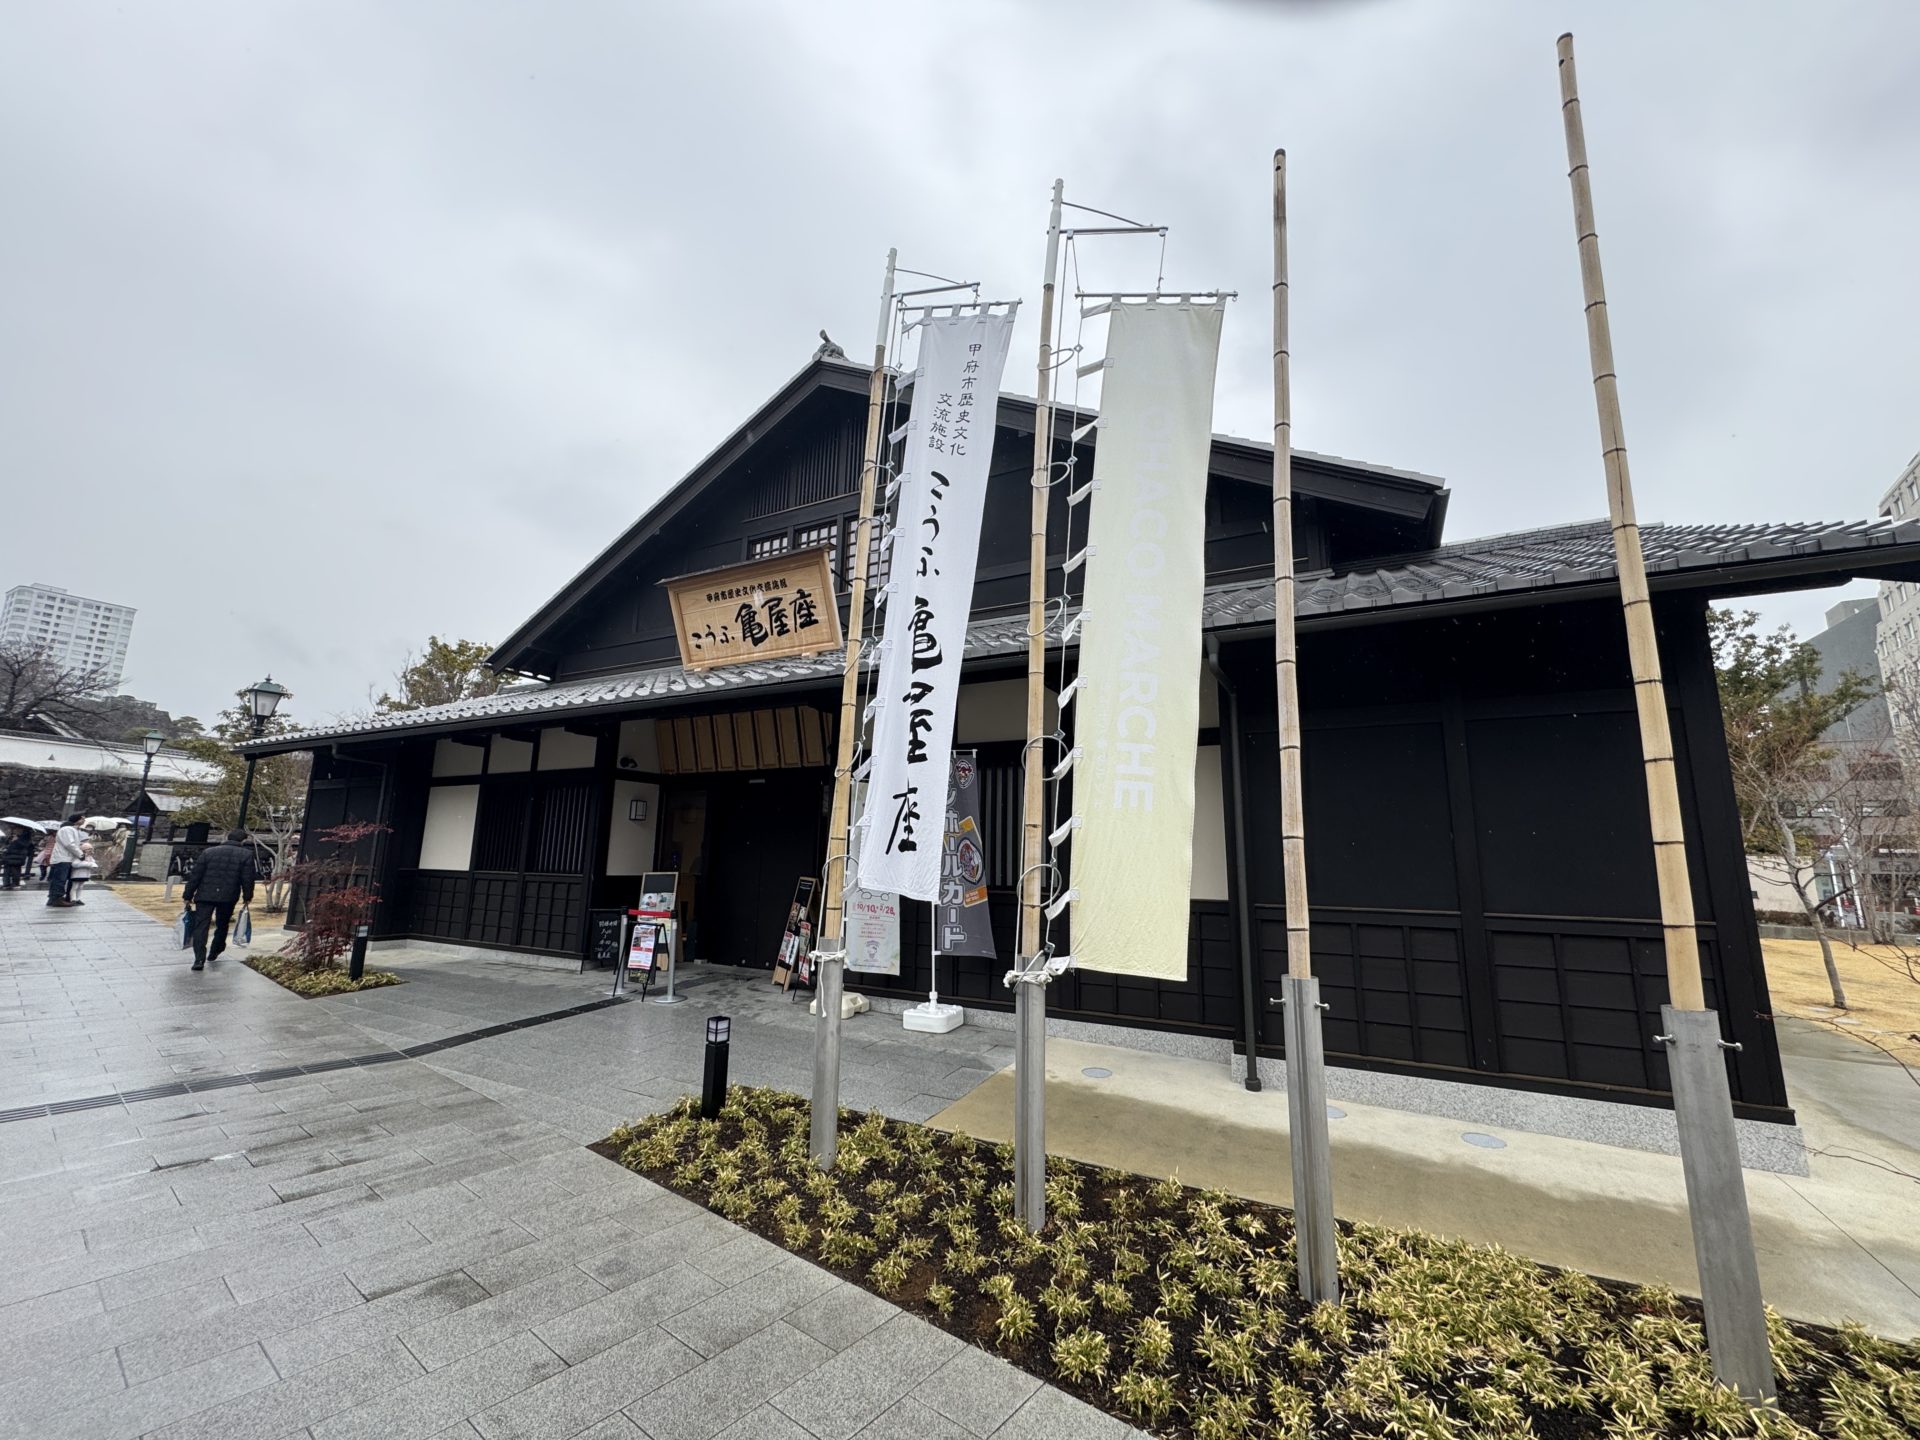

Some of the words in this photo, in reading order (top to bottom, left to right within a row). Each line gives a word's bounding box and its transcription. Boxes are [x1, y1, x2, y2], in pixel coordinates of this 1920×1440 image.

[929, 392, 953, 454] 交流施設
[949, 342, 983, 457] 甲府市歴史文化
[1115, 593, 1162, 812] MARCHE
